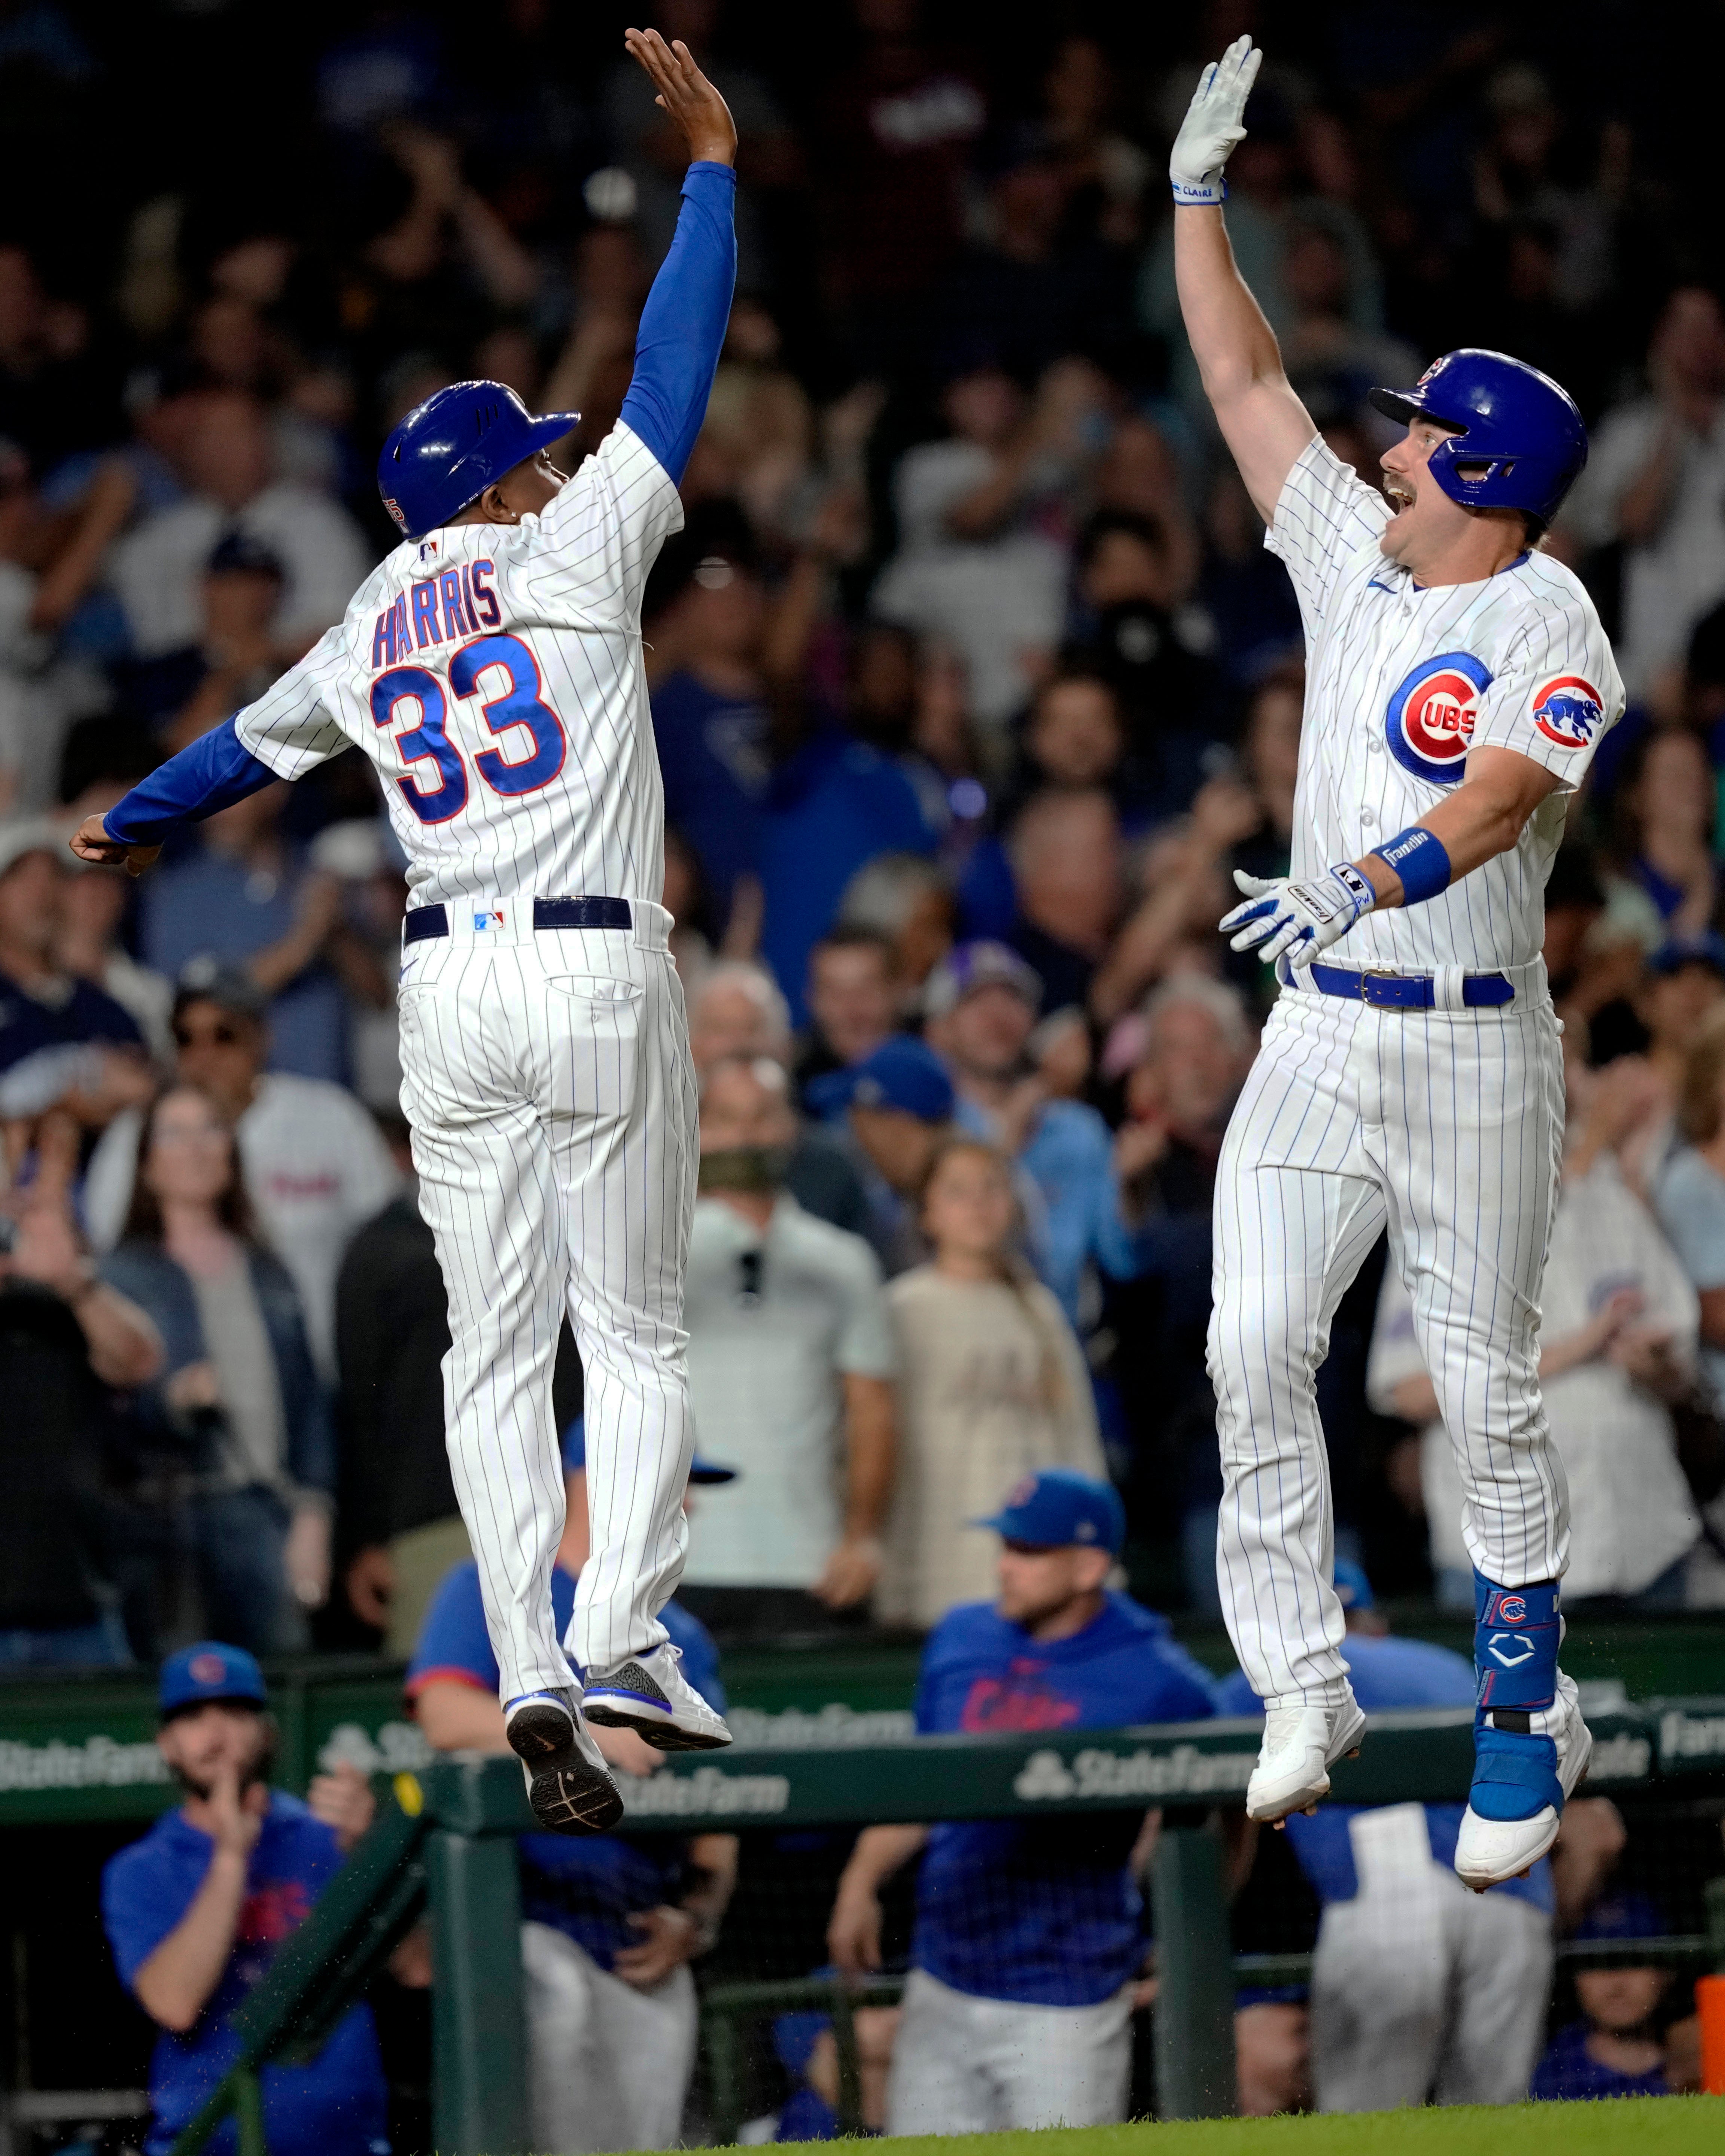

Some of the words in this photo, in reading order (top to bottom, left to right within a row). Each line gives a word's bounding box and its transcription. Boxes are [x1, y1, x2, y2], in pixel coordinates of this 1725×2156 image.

[1183, 186, 1213, 198] CLAIRE
[372, 559, 501, 669] HARRIS
[370, 633, 567, 825] 33
[1382, 832, 1429, 867] Franklin
